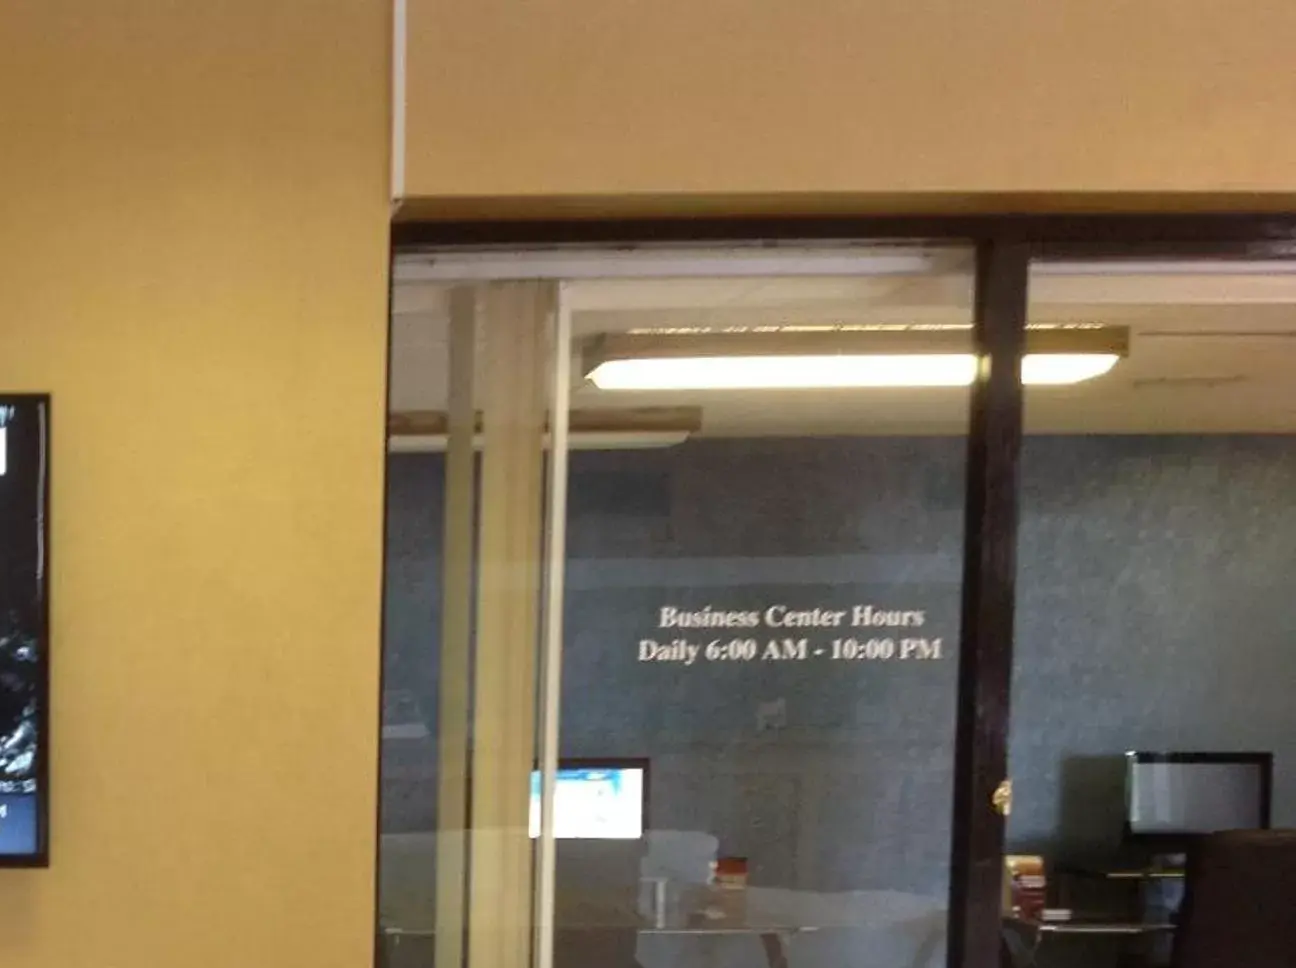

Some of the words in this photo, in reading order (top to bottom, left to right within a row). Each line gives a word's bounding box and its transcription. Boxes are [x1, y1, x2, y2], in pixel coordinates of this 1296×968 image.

[659, 605, 760, 628] Business
[764, 605, 847, 628] Center
[851, 605, 926, 628] Hours
[638, 638, 700, 665] Daily
[705, 638, 756, 661] 6:00
[761, 638, 809, 661] AM
[831, 638, 894, 661] 10:00
[899, 638, 944, 661] PM
